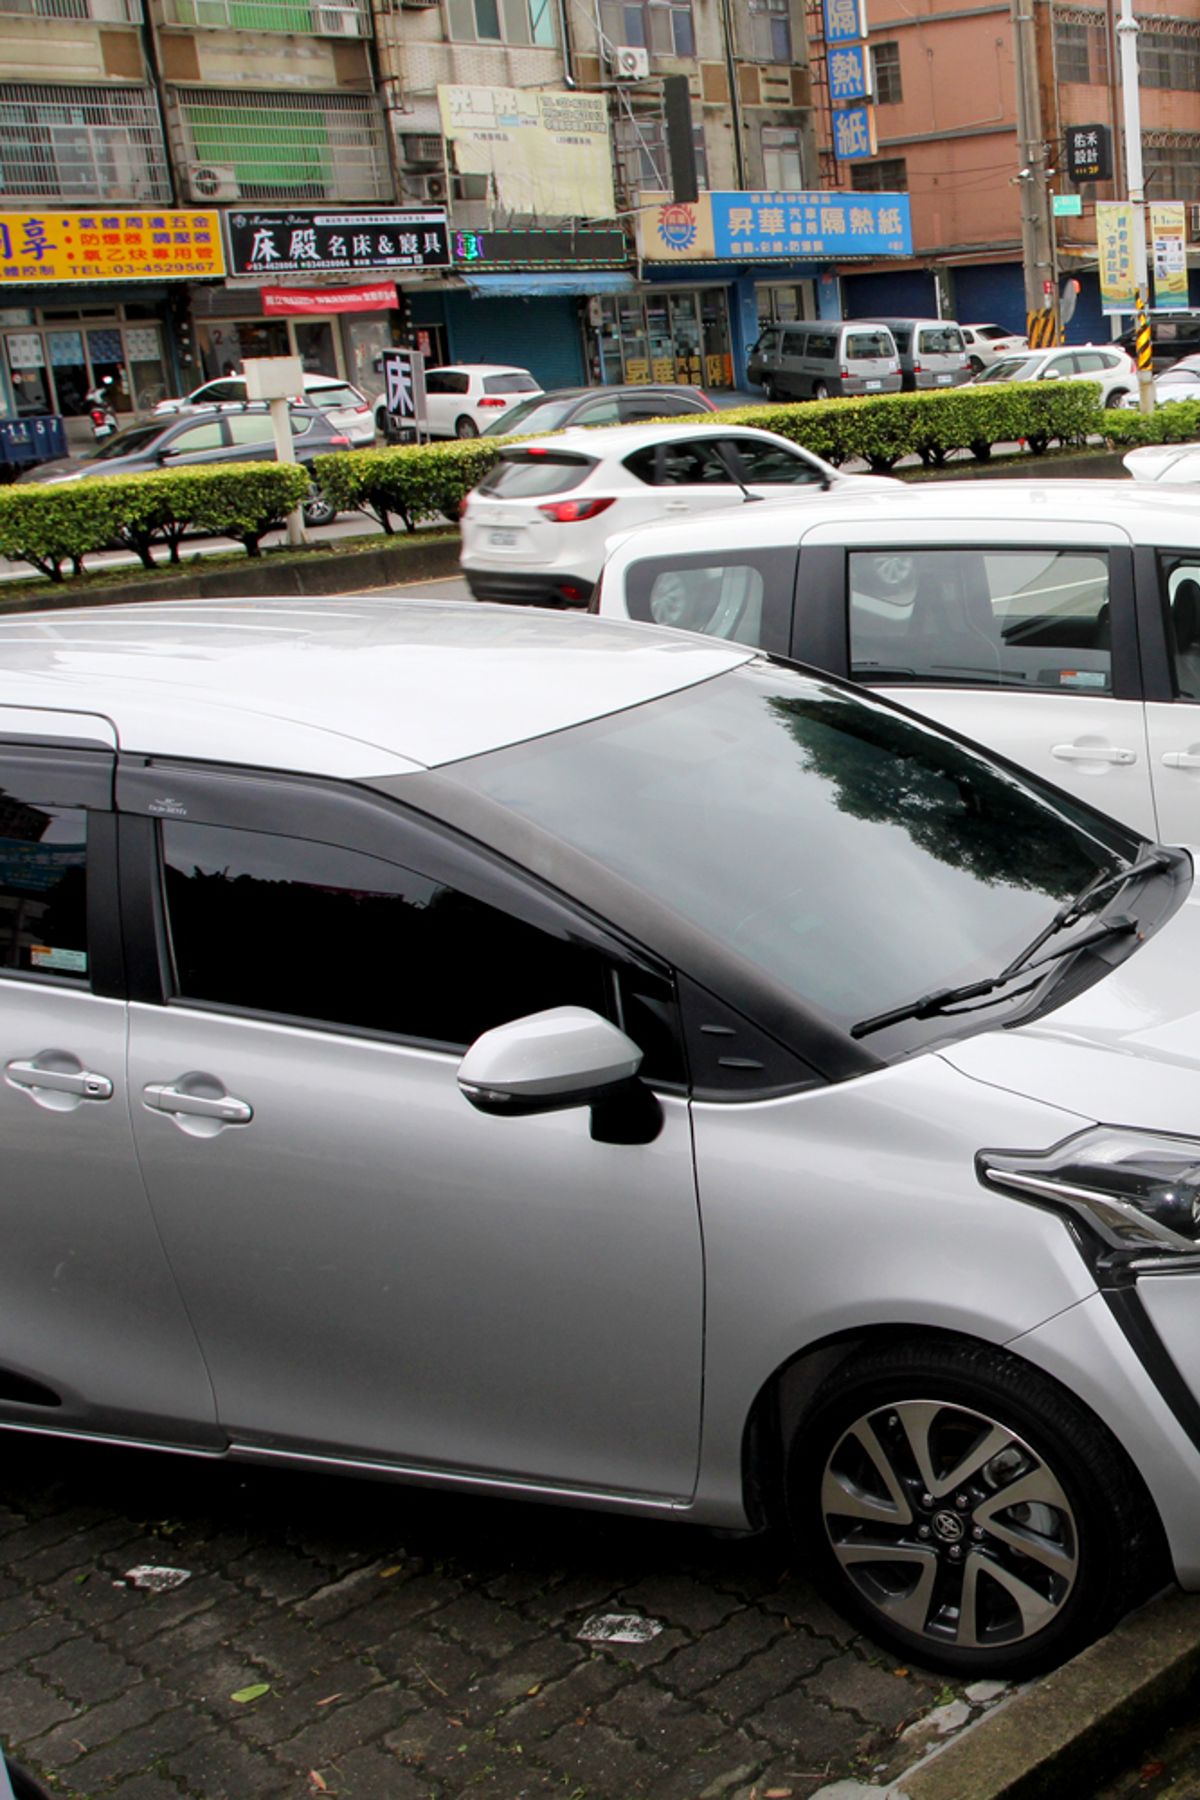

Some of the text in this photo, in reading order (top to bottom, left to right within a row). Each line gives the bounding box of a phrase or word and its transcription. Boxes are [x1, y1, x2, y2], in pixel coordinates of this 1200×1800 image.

[828, 0, 868, 156] 隔熱紙
[1074, 149, 1098, 164] 設計
[728, 207, 785, 236] 昇華
[821, 208, 902, 235] 隔熱紙
[251, 228, 322, 262] 床殿
[0, 265, 55, 277] 體控制
[386, 355, 414, 416] 床
